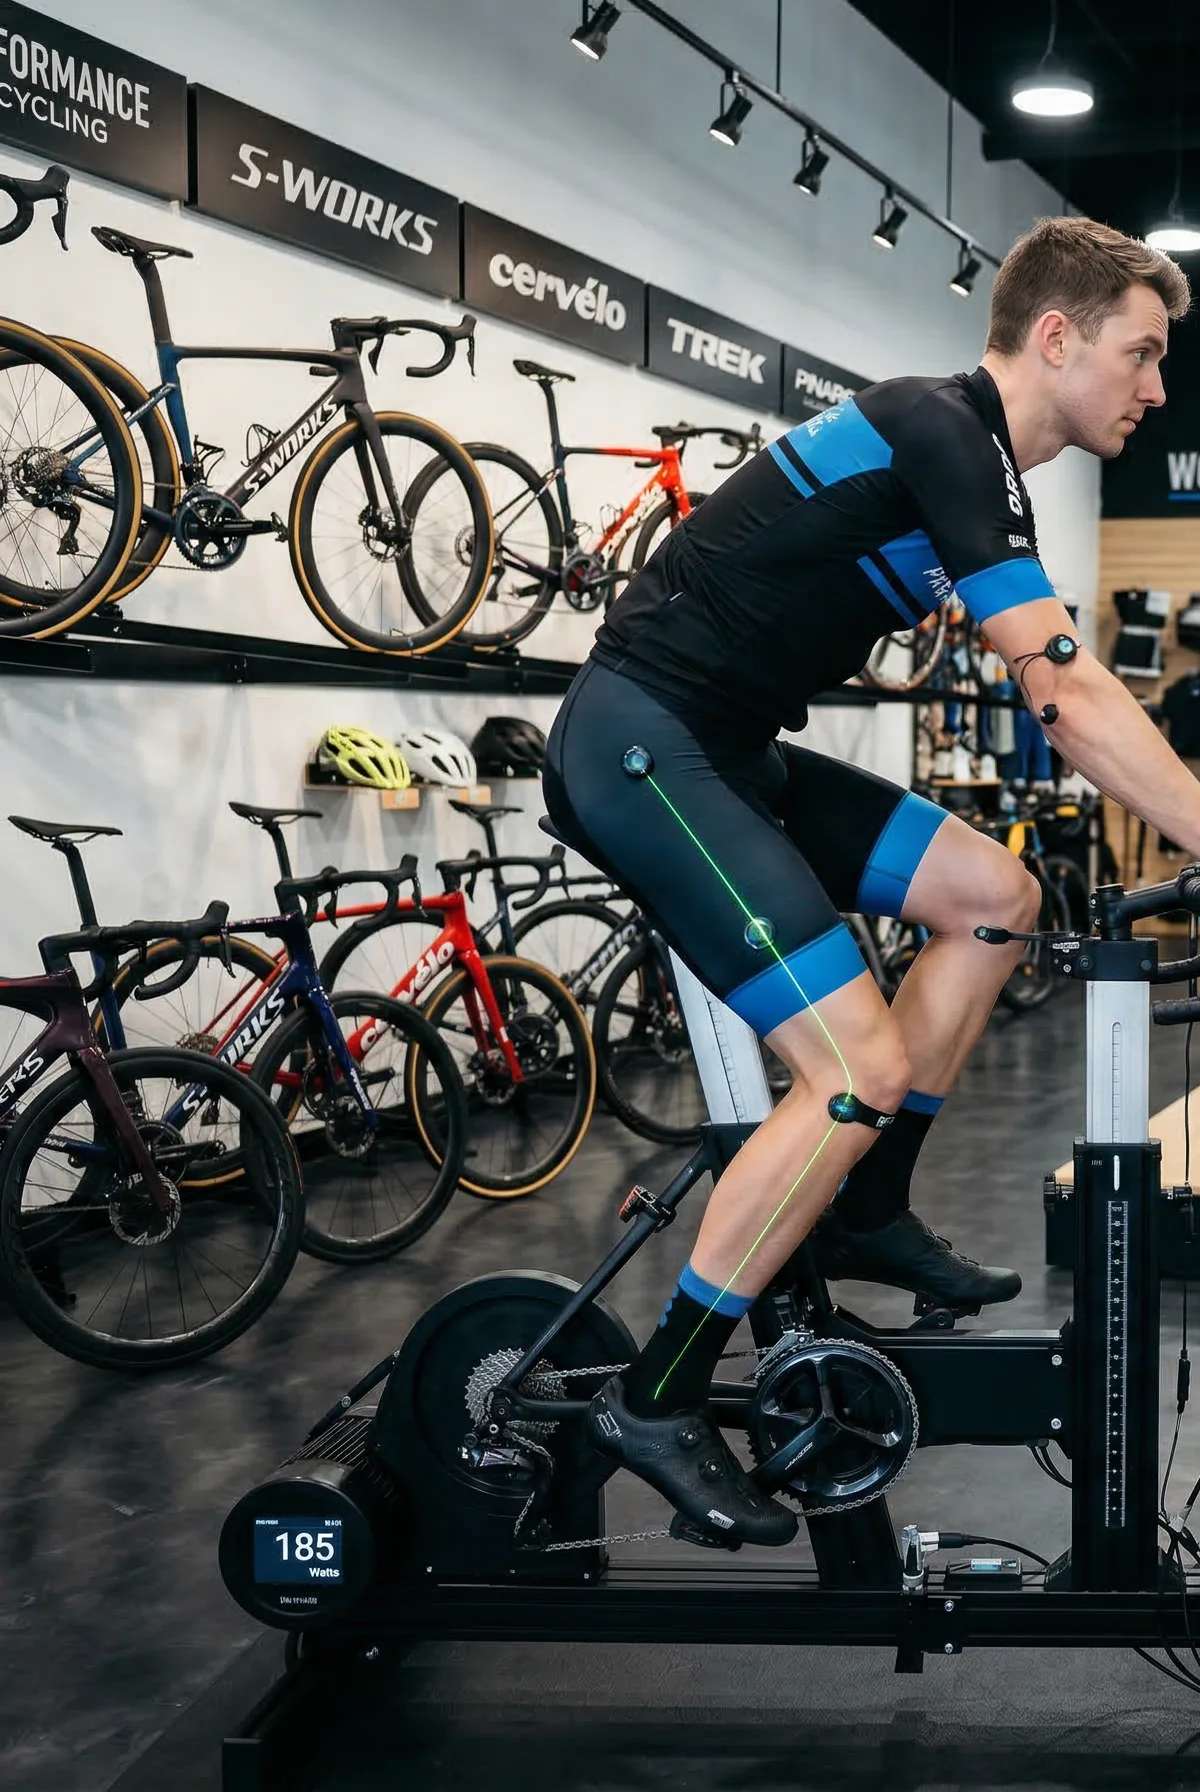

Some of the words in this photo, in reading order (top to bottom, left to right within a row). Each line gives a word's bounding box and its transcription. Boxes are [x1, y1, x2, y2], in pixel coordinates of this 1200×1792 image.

[0, 82, 108, 144] CYCLING
[231, 143, 438, 256] S-WORKS
[488, 253, 628, 332] cervélo
[666, 317, 767, 384] TREK
[243, 393, 339, 500] S-WORKS
[360, 941, 455, 1052] cvélo
[182, 985, 286, 1120] S-ORKS
[275, 1531, 335, 1562] 185
[308, 1567, 341, 1578] Watts
